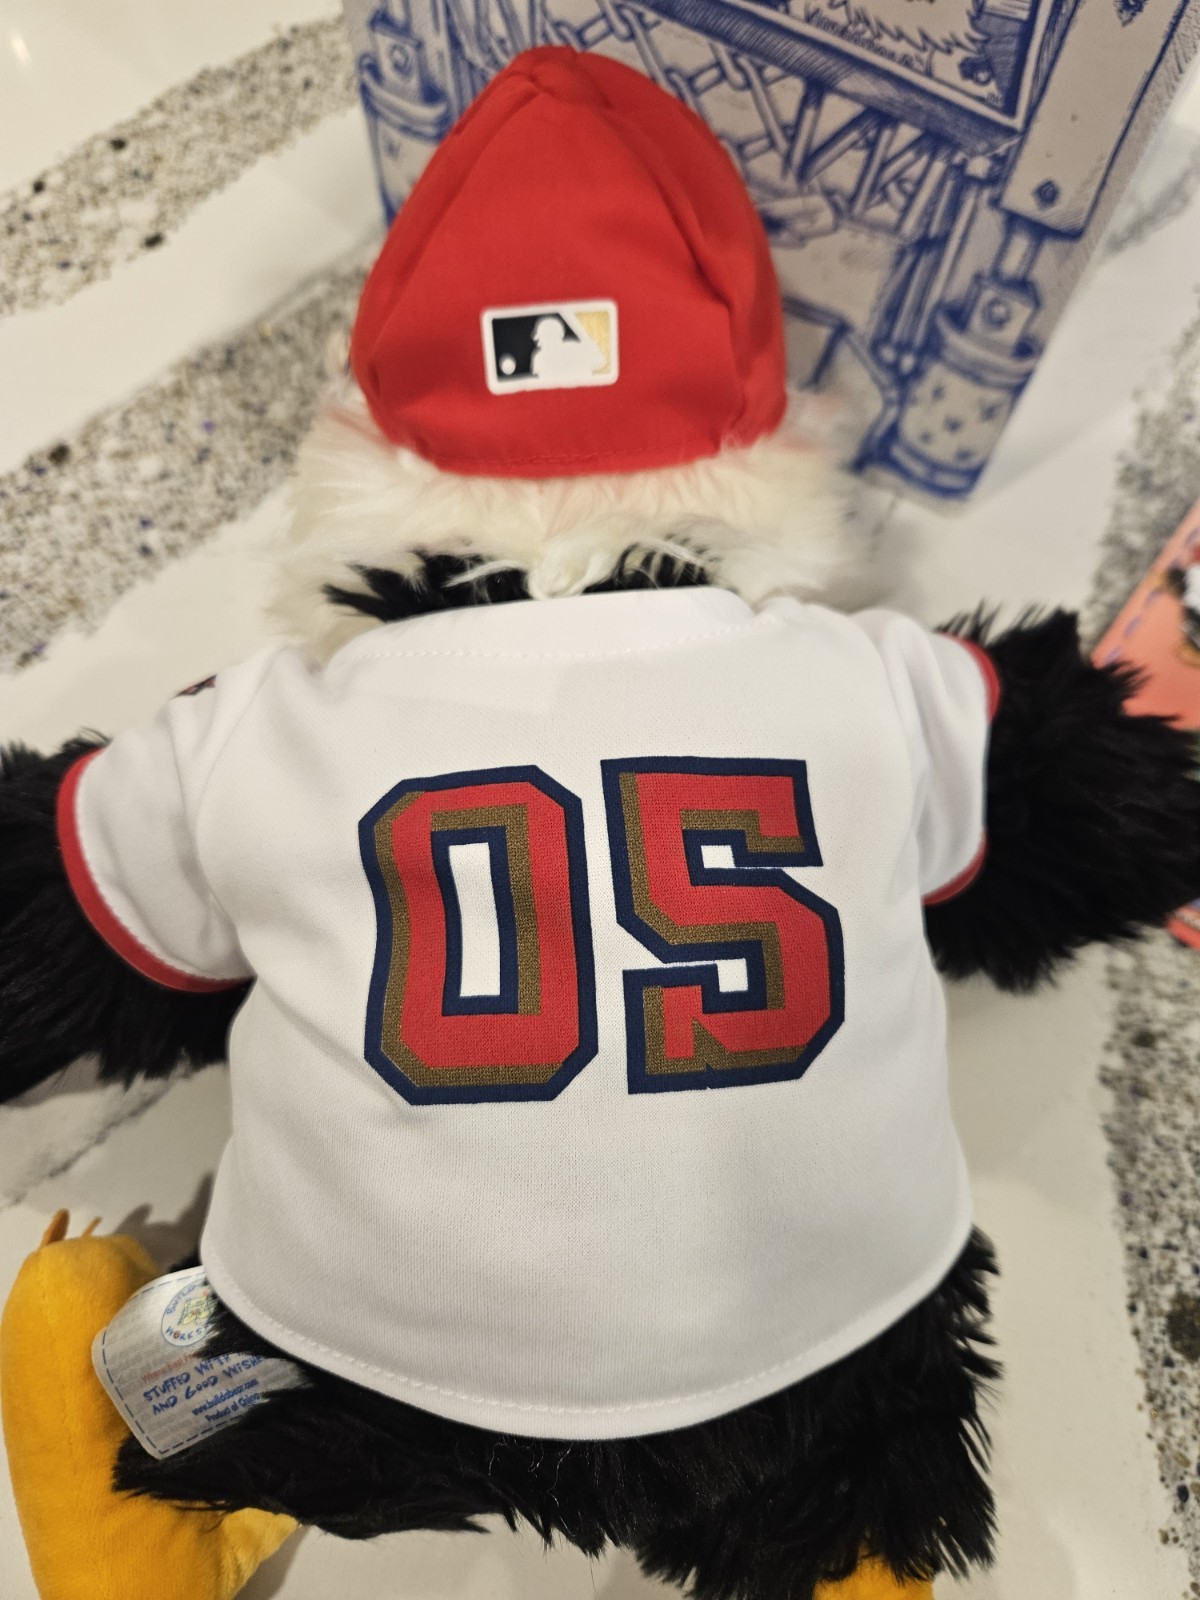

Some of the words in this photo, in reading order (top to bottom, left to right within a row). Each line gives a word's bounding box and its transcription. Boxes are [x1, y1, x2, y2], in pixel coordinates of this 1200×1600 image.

[358, 756, 845, 1106] 05
[143, 1372, 191, 1402] STUFFED
[152, 1395, 178, 1416] AND
[185, 1375, 218, 1400] GOOD
